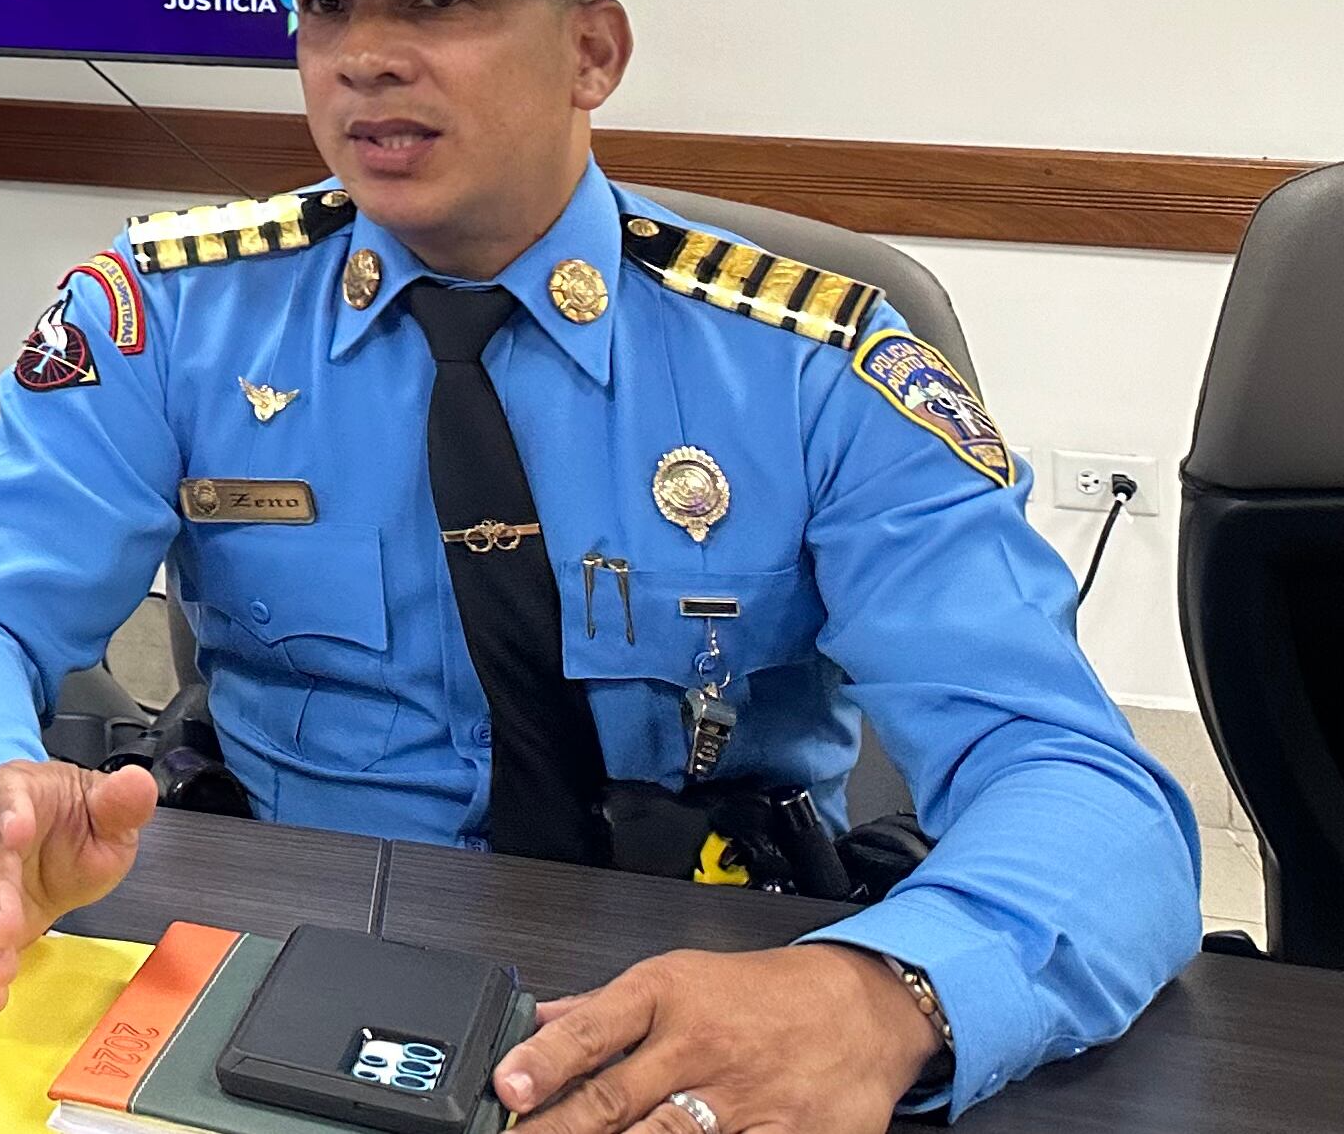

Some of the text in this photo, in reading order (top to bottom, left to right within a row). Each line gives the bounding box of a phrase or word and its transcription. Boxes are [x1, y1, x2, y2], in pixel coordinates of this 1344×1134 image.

[113, 274, 135, 344] CARRETERAS
[887, 355, 926, 397] PUERTO
[229, 492, 300, 509] Zeno
[83, 1022, 160, 1079] 2024
